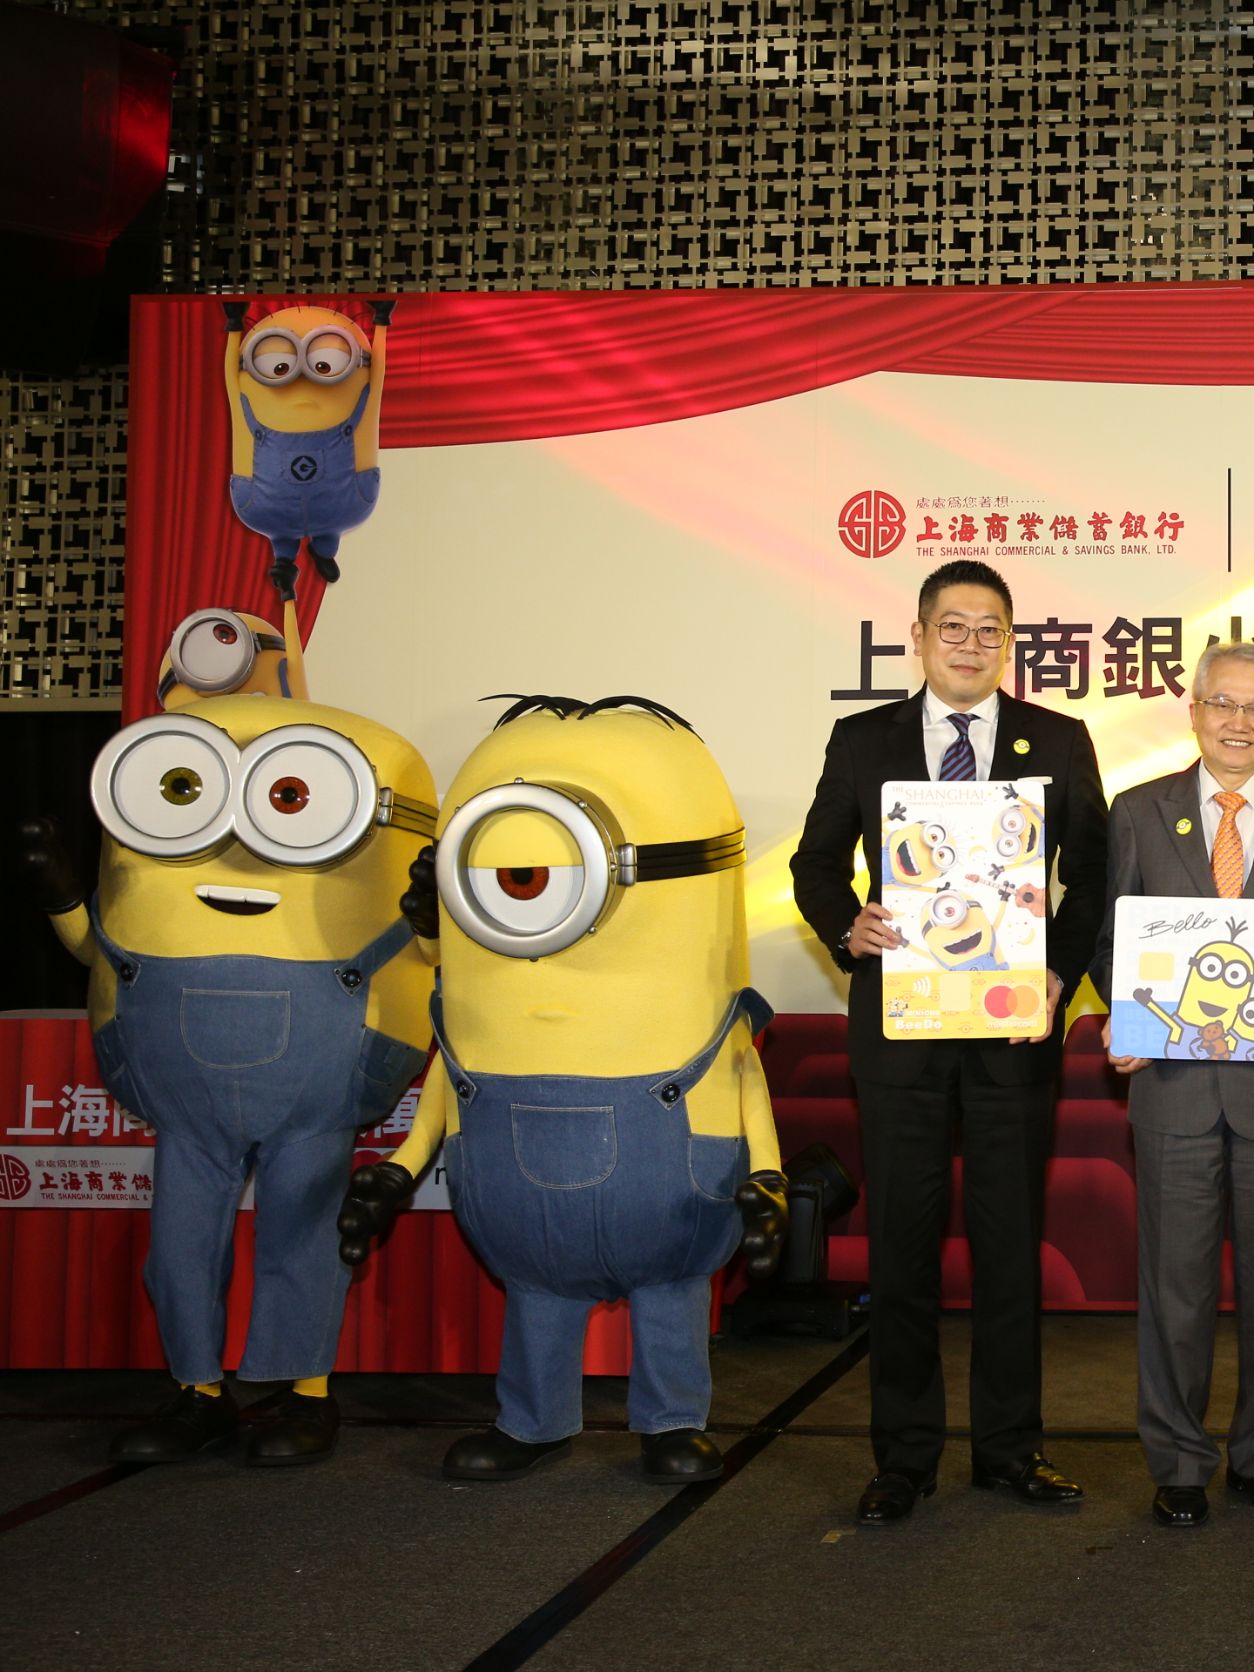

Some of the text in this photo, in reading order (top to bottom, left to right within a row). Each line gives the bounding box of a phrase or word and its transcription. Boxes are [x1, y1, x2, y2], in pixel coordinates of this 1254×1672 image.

[916, 511, 1185, 543] 上海商業儲蓄銀行
[916, 547, 935, 557] THE
[940, 546, 989, 557] SHANGHAI
[995, 545, 1056, 556] COMMERCIAL
[1062, 545, 1069, 555] &
[1074, 544, 1115, 555] SAVINGS
[1156, 544, 1177, 555] LTD.
[905, 788, 984, 800] SHANGHAI
[1138, 911, 1217, 939] Bello
[41, 1192, 55, 1200] THE
[58, 1192, 93, 1200] SHANGHAI
[97, 1193, 139, 1201] COMMERCIAL
